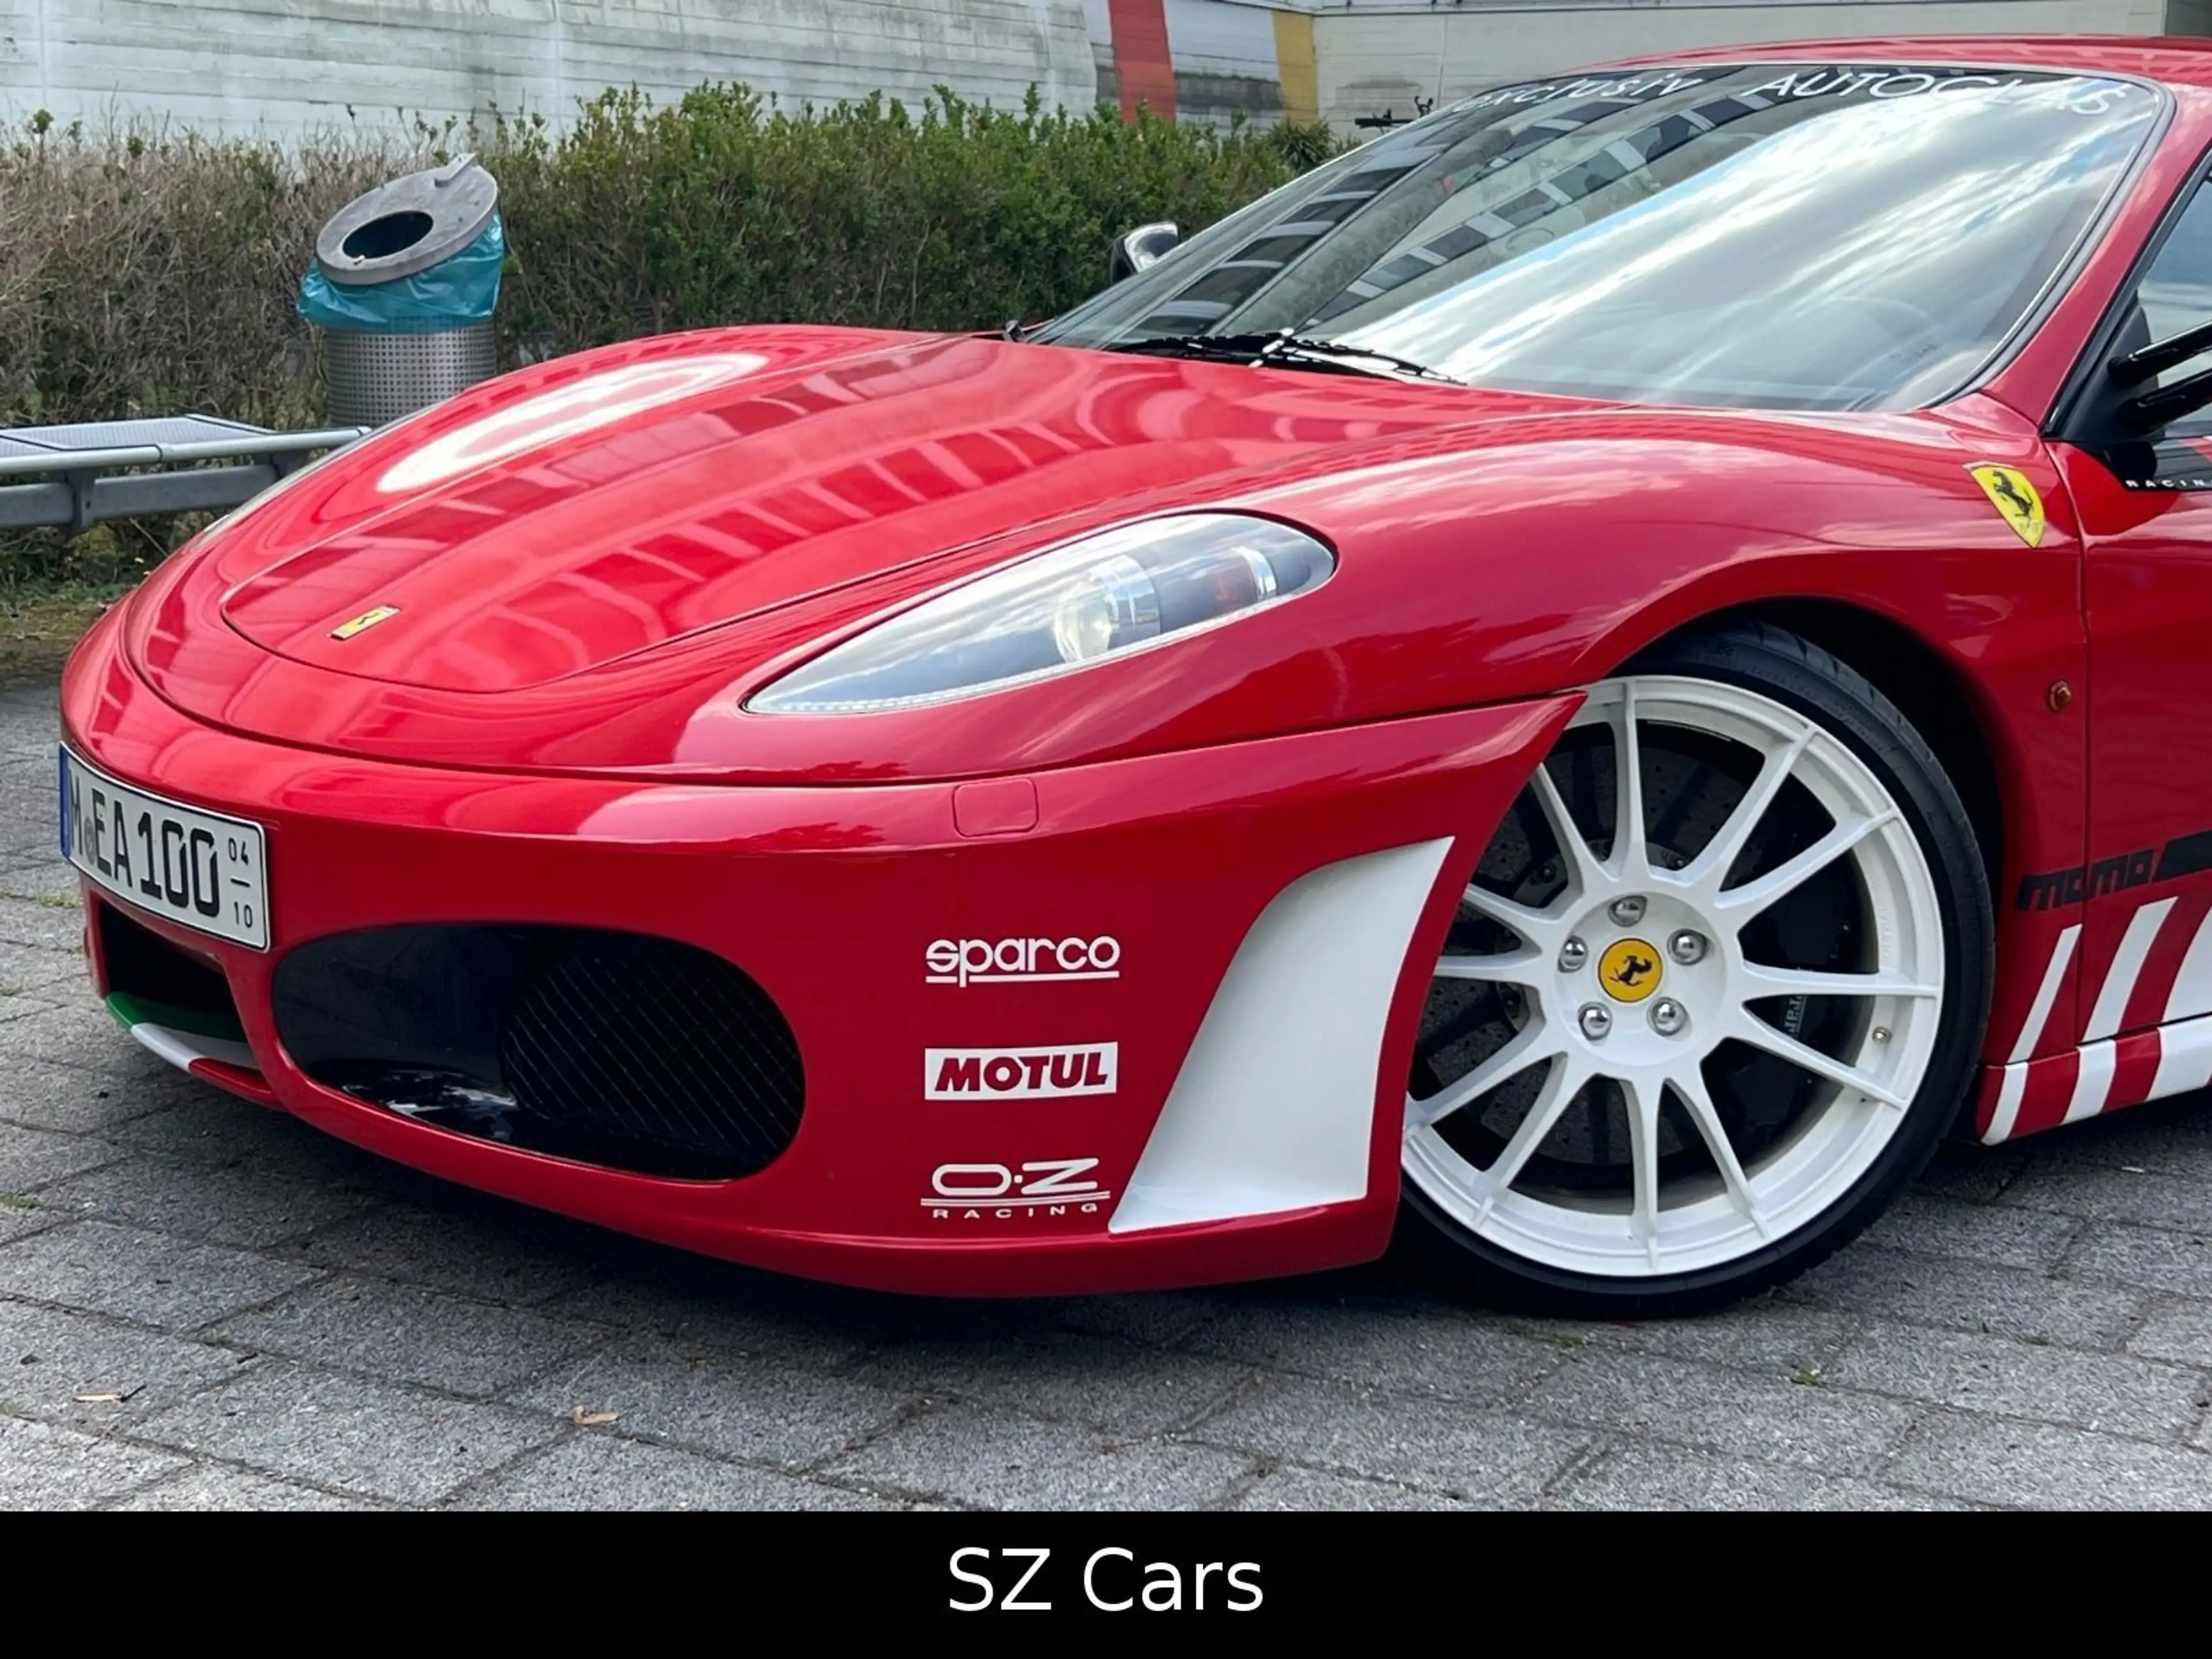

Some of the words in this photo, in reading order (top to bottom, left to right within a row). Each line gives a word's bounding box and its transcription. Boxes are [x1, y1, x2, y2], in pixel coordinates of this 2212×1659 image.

[2124, 479, 2212, 488] RACIN
[92, 787, 133, 888] EA
[138, 811, 220, 918] 100
[228, 837, 249, 866] 04
[233, 901, 253, 929] 10
[926, 935, 1120, 987] sparco
[934, 1051, 1108, 1092] MOTUL
[932, 1203, 1097, 1219] RACING
